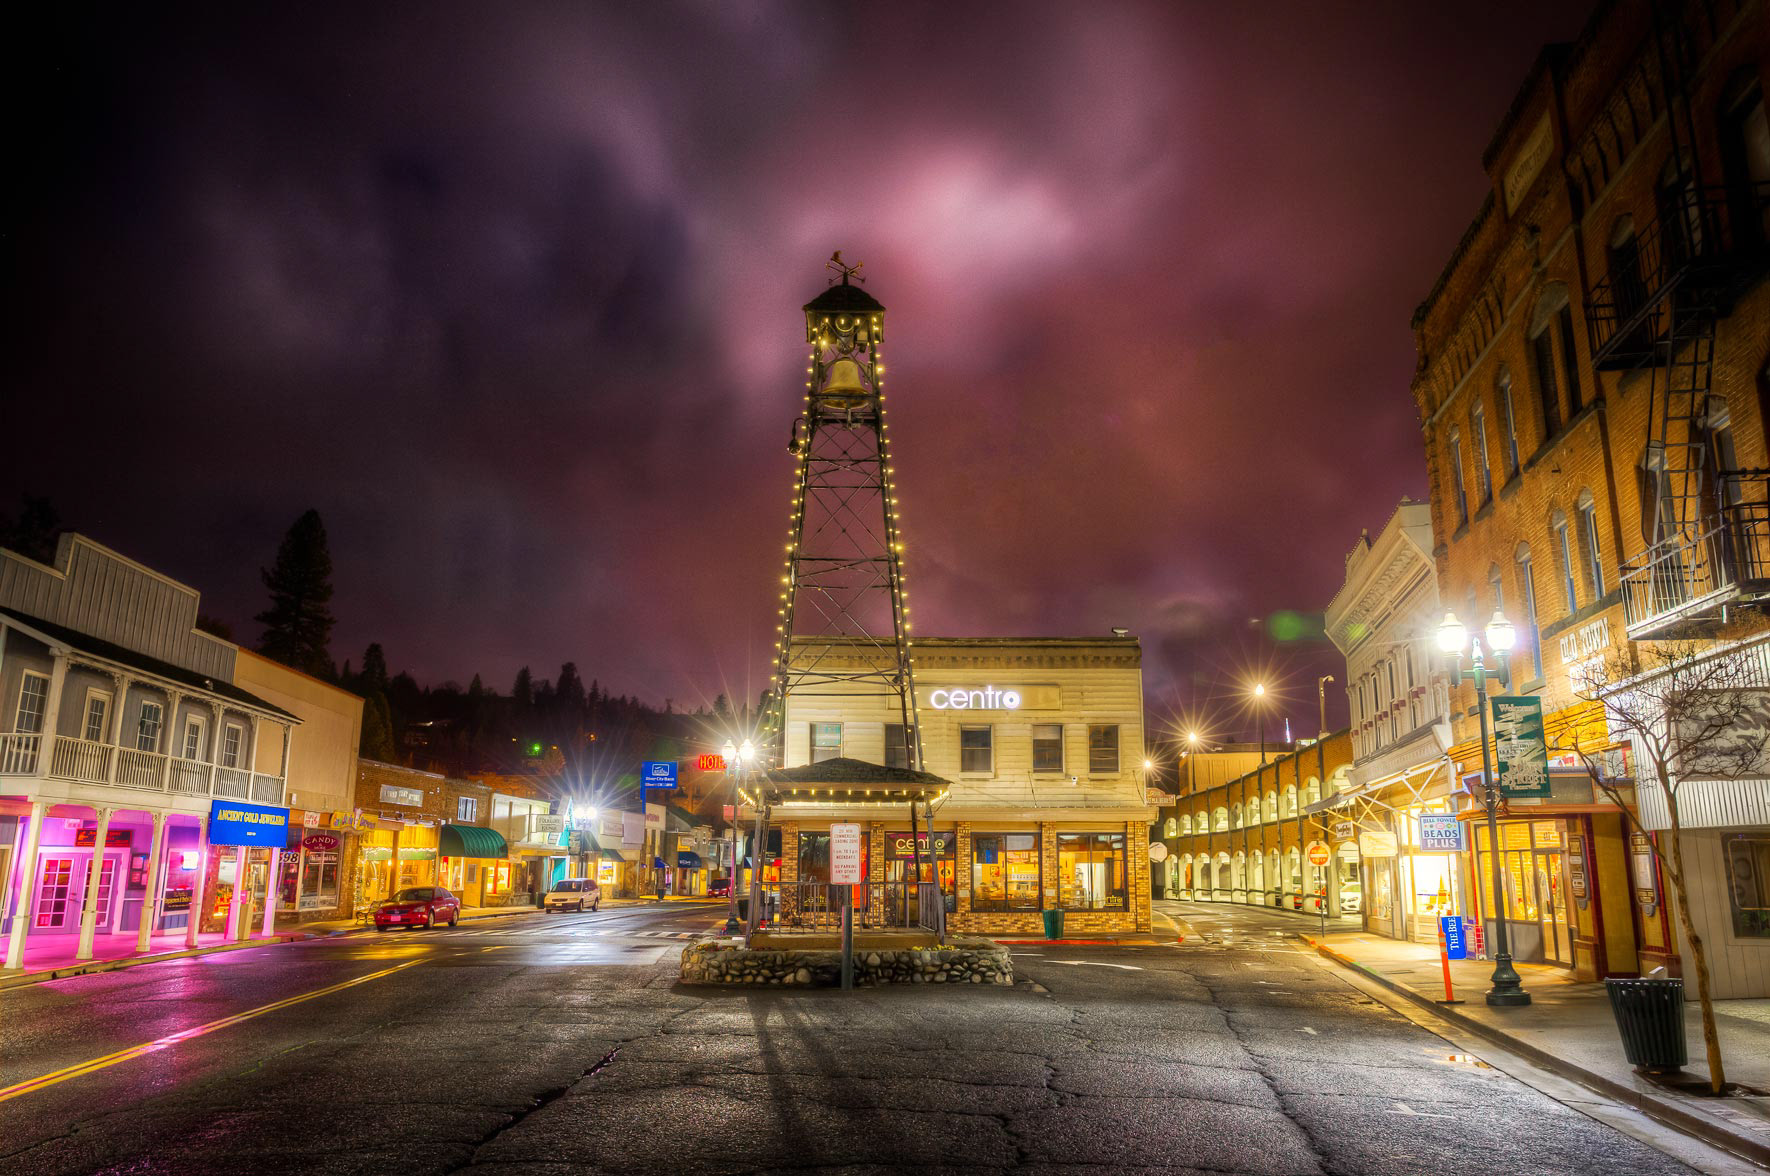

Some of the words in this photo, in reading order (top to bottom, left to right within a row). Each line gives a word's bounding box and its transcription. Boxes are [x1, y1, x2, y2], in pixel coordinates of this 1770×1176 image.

[1579, 616, 1611, 657] TOWN
[930, 685, 1020, 709] centro
[217, 809, 244, 822] ANCIENT
[243, 812, 259, 823] GOLD
[304, 836, 336, 845] CANDY
[1427, 838, 1457, 848] PLUS
[1450, 933, 1460, 950] THE
